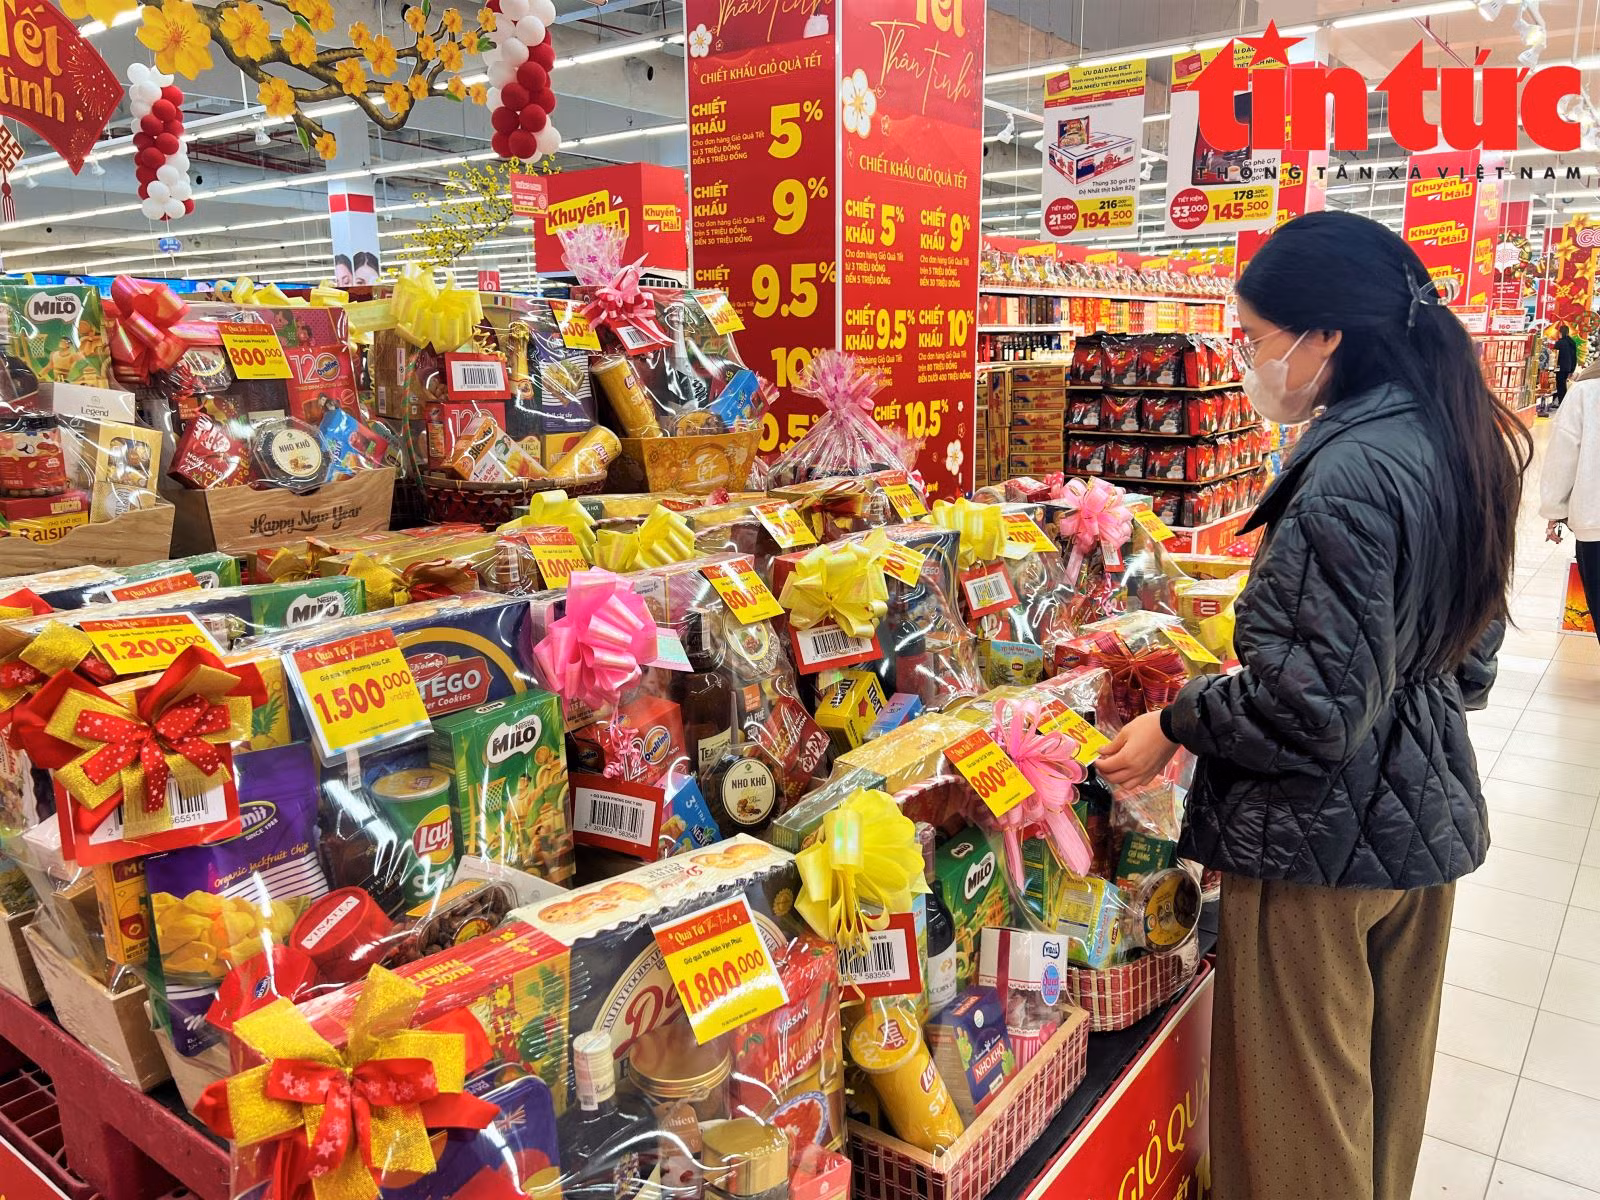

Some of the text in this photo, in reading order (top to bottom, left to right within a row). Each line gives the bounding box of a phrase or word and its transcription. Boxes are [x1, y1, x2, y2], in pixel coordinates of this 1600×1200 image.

[701, 50, 823, 85] CHIẾT KHẤU GIỎ QUÀ TẾT
[691, 96, 727, 117] CHIẾT
[691, 115, 726, 136] KHẤU
[768, 99, 824, 159] 5%
[692, 138, 704, 147] Cho
[704, 136, 716, 146] đơn
[716, 135, 731, 144] hàng
[731, 132, 741, 142] Giỏ
[704, 145, 722, 155] TRIỆU
[722, 142, 741, 151] ĐỒNG
[692, 155, 706, 165] ĐẾN
[711, 154, 728, 164] TRIỆU
[729, 151, 748, 161] ĐỒNG
[859, 152, 968, 190] CHIẾT KHẤU GIỎ QUÀ TẾT
[693, 180, 729, 199] CHIẾT
[1413, 177, 1458, 194] Khuyến
[548, 196, 607, 228] Khuyến
[644, 205, 675, 220] Khuyến
[693, 198, 728, 217] KHẤU
[772, 176, 829, 235] 9%
[845, 196, 876, 220] CHIẾT
[920, 205, 947, 228] CHIẾT
[1172, 203, 1208, 219] 33.000
[1213, 201, 1269, 221] 145.500
[879, 203, 905, 247] 5%
[1048, 212, 1077, 226] 21.500
[1081, 209, 1132, 229] 194.500
[845, 220, 875, 245] KHẤU
[920, 229, 945, 251] KHẤU
[949, 213, 971, 253] 9%
[1410, 223, 1454, 239] Khuyến
[695, 263, 731, 282] CHIẾT
[751, 261, 837, 319] 9.5%
[33, 299, 76, 316] MILO
[845, 303, 875, 326] CHIẾT
[918, 304, 944, 325] CHIẾT
[845, 327, 875, 351] KHẤU
[876, 308, 915, 350] 9.5%
[918, 326, 943, 348] KHẤU
[947, 309, 975, 347] 10%
[229, 346, 282, 367] 800.000
[316, 359, 339, 377] Ovaltine
[80, 406, 109, 418] Legend
[873, 398, 902, 421] CHIẾT
[904, 398, 949, 440] 10.5%
[278, 438, 311, 454] NHO KHÔ
[250, 505, 362, 537] Happy New Year
[19, 525, 82, 544] Raisin
[721, 584, 768, 612] 800.000
[292, 604, 340, 624] MILO
[101, 634, 206, 661] 1.200.000
[418, 668, 482, 700] TEGO
[313, 669, 411, 725] 1.500.000
[438, 692, 472, 706] Cookies
[754, 707, 766, 721] PHÊ
[492, 726, 537, 757] MILO
[643, 731, 669, 762] Ovaltine
[731, 774, 767, 790] NHO KHÔ
[970, 757, 1014, 799] 800.000
[240, 805, 267, 829] mit
[108, 828, 114, 836] 2
[245, 827, 264, 841] SINCE
[418, 818, 452, 854] Lay
[967, 861, 993, 894] MILO
[304, 899, 354, 943] VINATEA
[692, 923, 706, 937] Tết
[625, 961, 651, 993] FOODS
[677, 948, 764, 1016] 1.800.000
[777, 1007, 810, 1034] VISSAN
[974, 1055, 992, 1080] NHO
